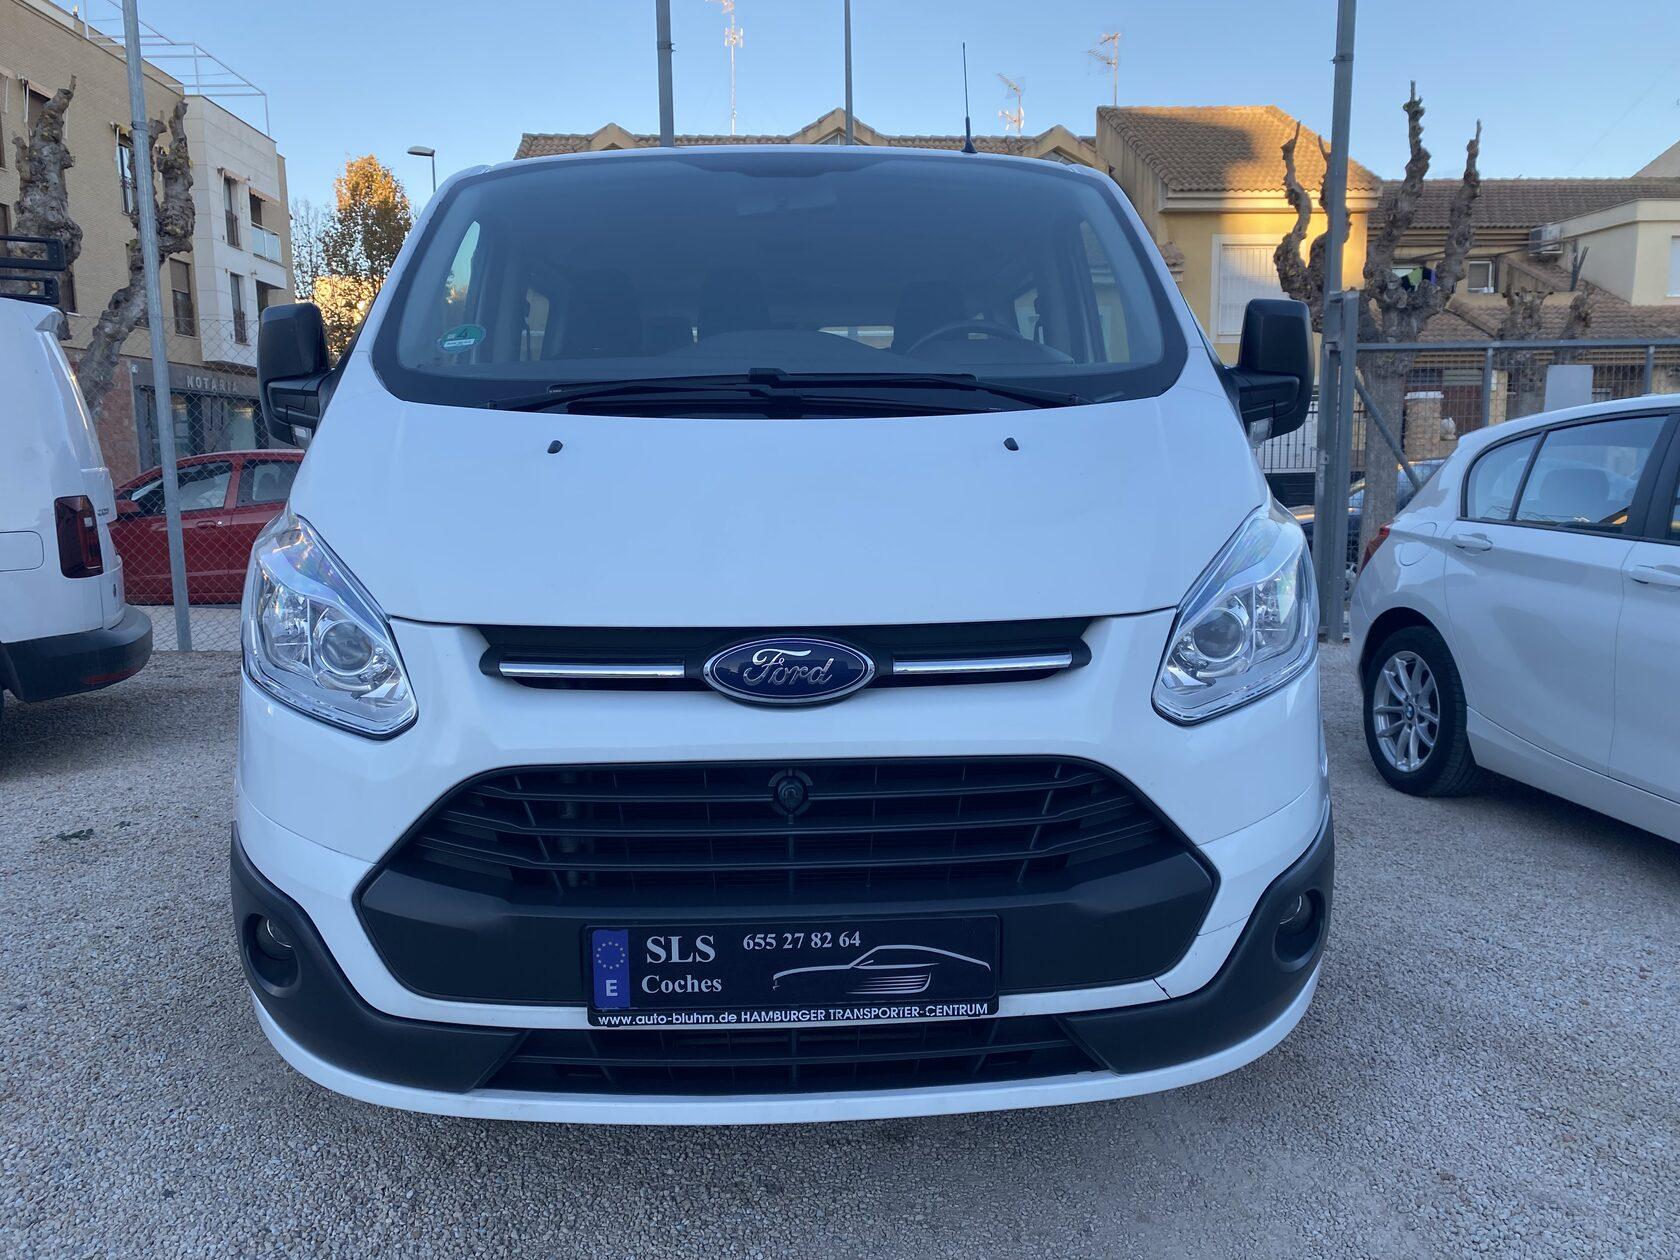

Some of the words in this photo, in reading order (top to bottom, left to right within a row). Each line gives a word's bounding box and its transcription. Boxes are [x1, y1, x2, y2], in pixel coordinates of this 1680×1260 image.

[743, 648, 833, 686] Ford
[646, 935, 716, 964] SLS
[743, 933, 777, 950] 655
[782, 932, 805, 949] 27
[810, 931, 833, 949] 82
[838, 930, 861, 948] 64
[605, 979, 618, 997] E
[641, 974, 722, 994] Coches
[598, 1011, 737, 1025] www.auto-bluhm.de
[741, 1009, 826, 1023] HAMBURGER
